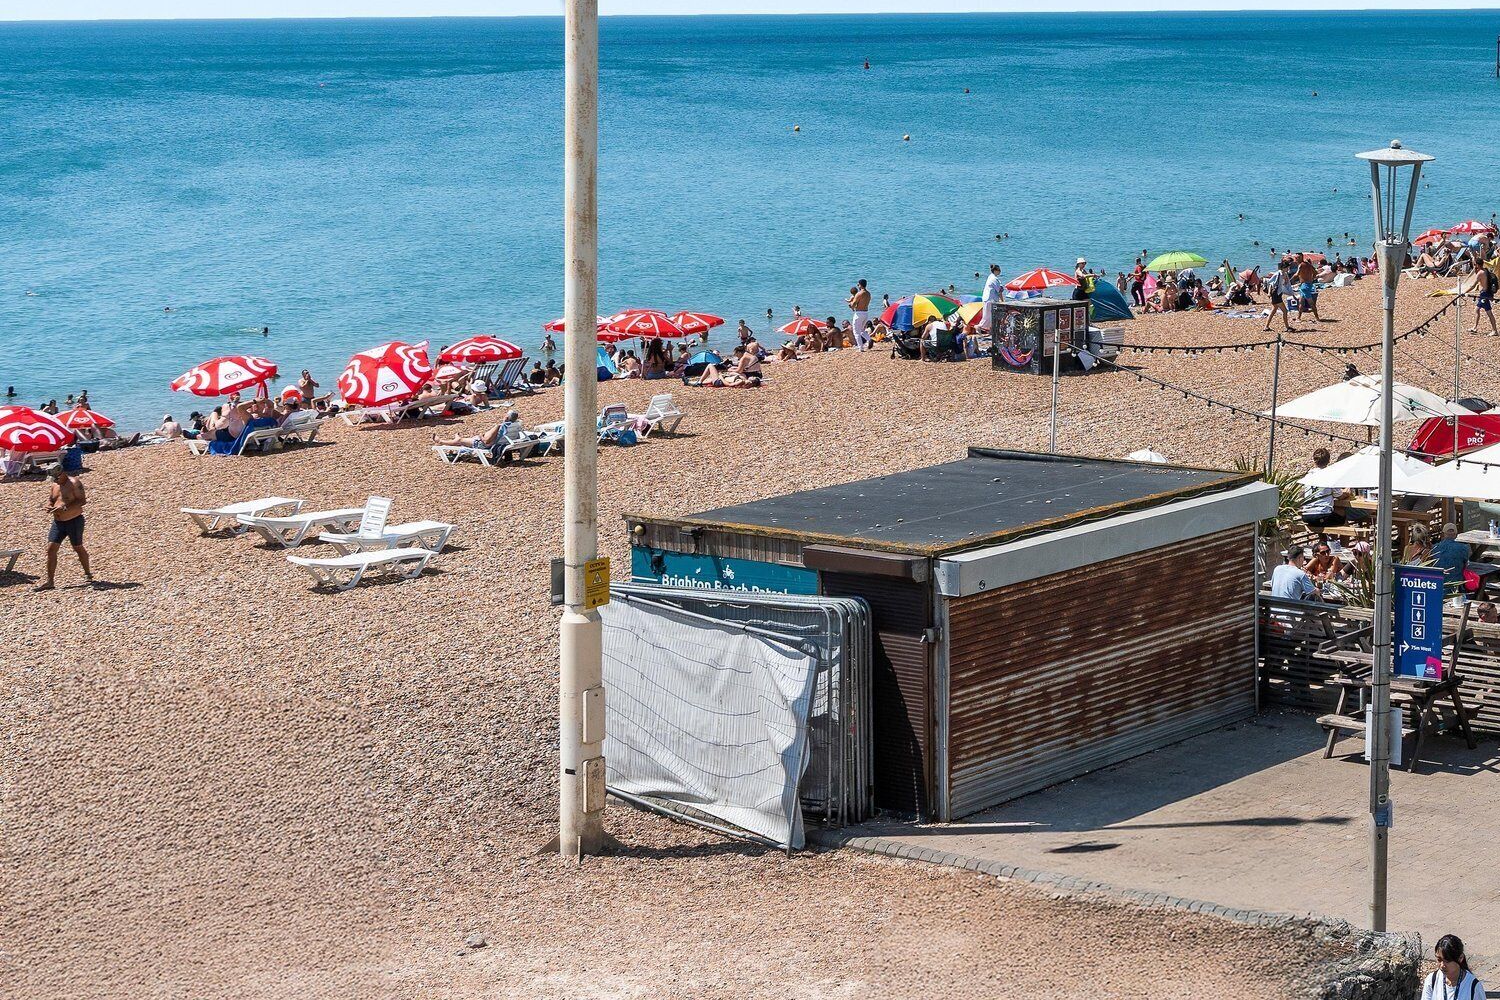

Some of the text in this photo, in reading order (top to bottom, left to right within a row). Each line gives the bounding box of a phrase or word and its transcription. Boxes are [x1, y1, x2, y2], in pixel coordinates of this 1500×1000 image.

[661, 574, 711, 589] Brighton
[714, 580, 748, 593] Beach
[1401, 577, 1437, 590] Toilets
